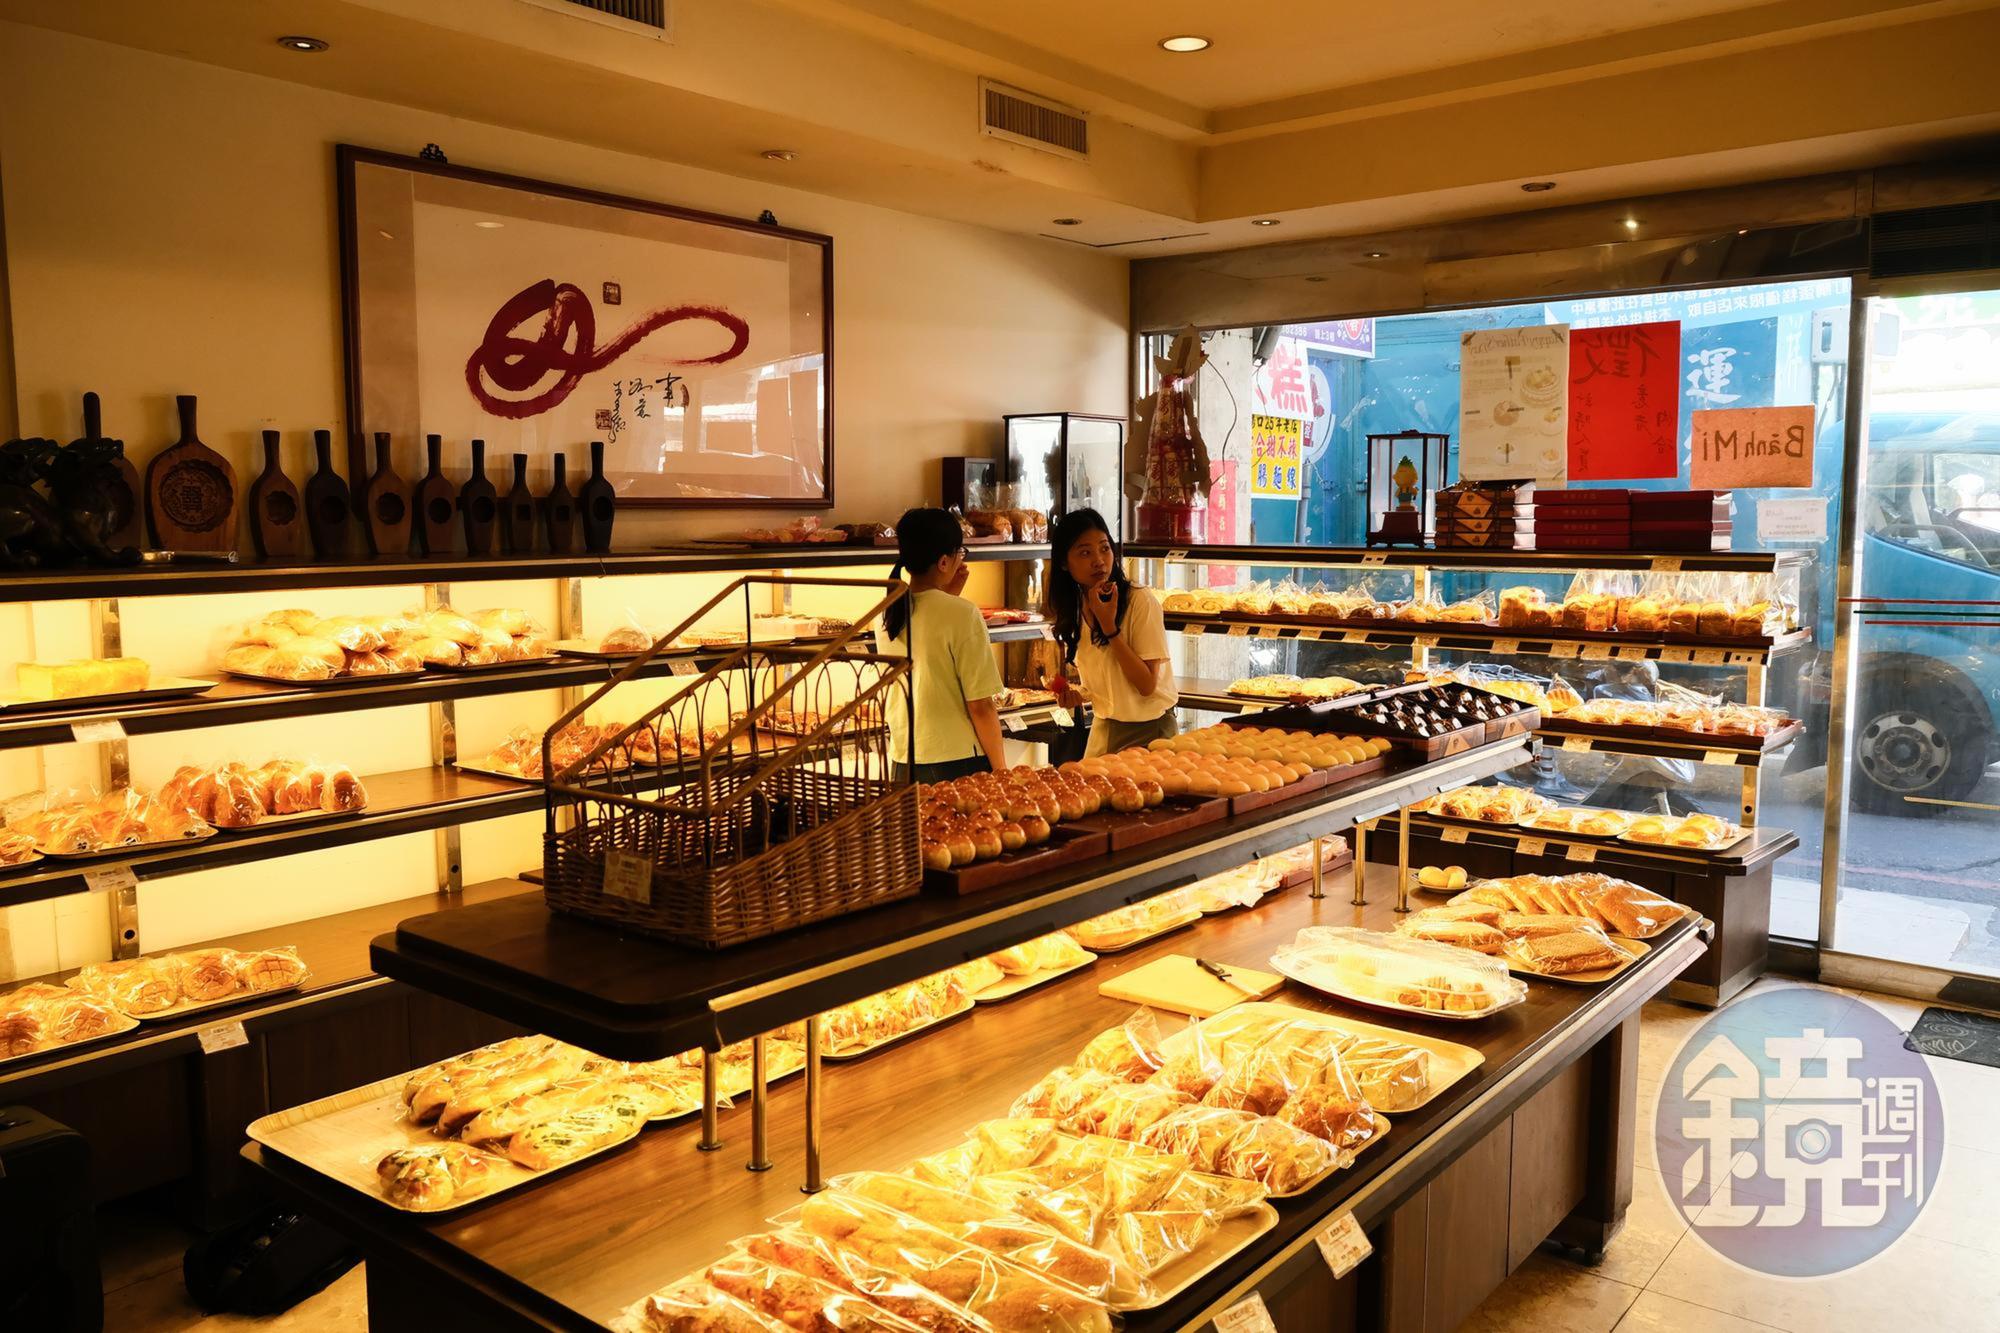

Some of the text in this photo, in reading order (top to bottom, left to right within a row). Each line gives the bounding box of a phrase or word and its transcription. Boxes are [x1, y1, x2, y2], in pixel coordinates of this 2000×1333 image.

[1255, 343, 1308, 413] 糕
[1252, 432, 1298, 460] 合甜不辣
